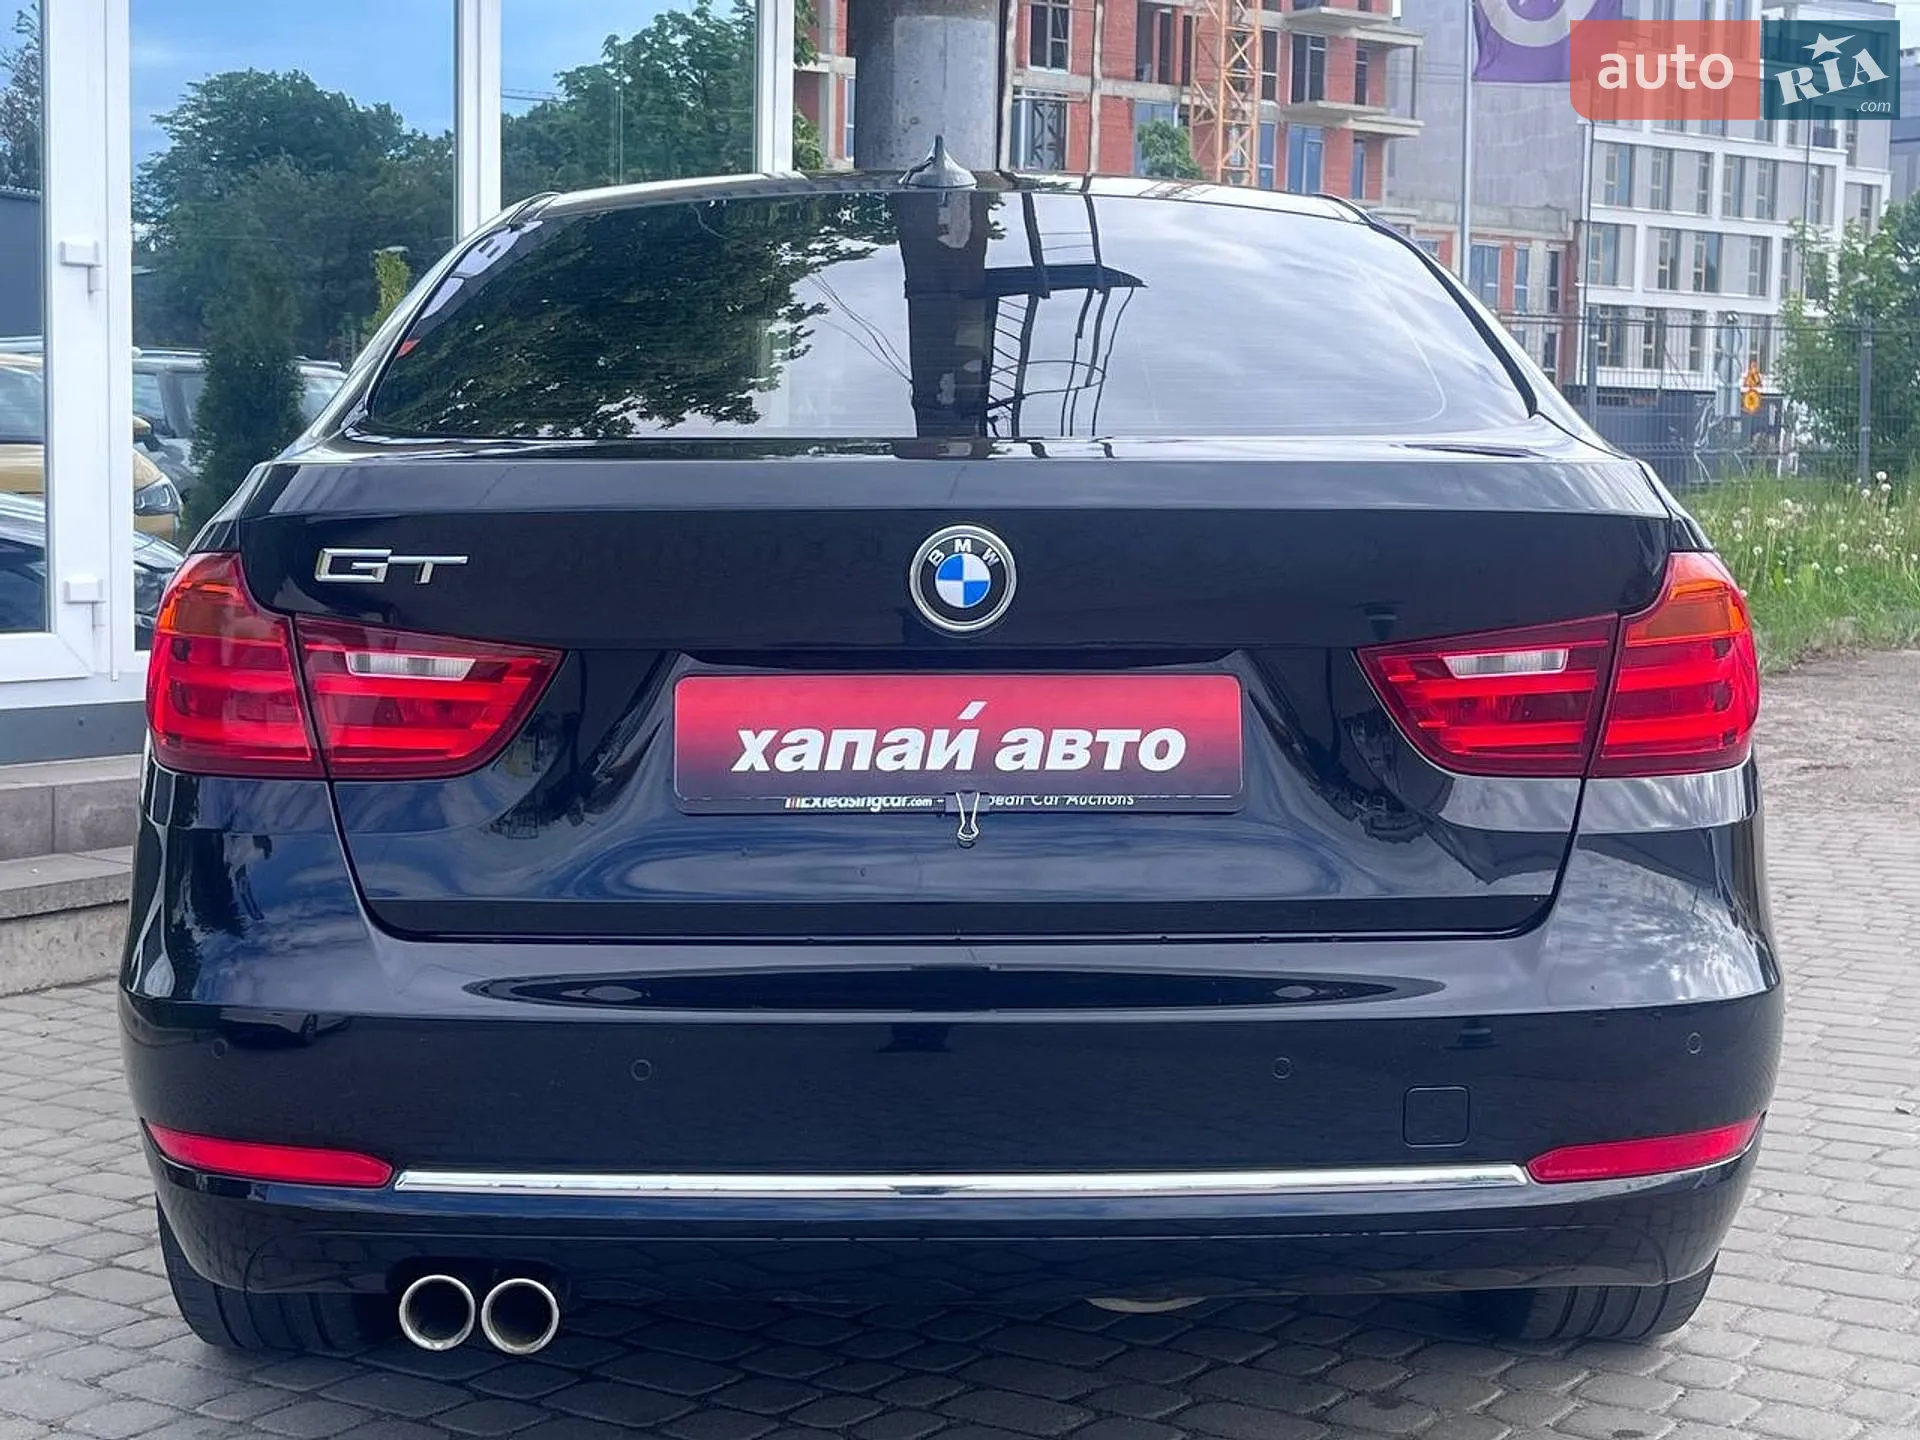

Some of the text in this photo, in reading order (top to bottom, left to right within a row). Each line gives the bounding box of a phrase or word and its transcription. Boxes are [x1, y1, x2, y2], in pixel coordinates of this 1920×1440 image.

[314, 548, 469, 584] GT
[928, 538, 1001, 567] BMW
[995, 727, 1187, 772] авто
